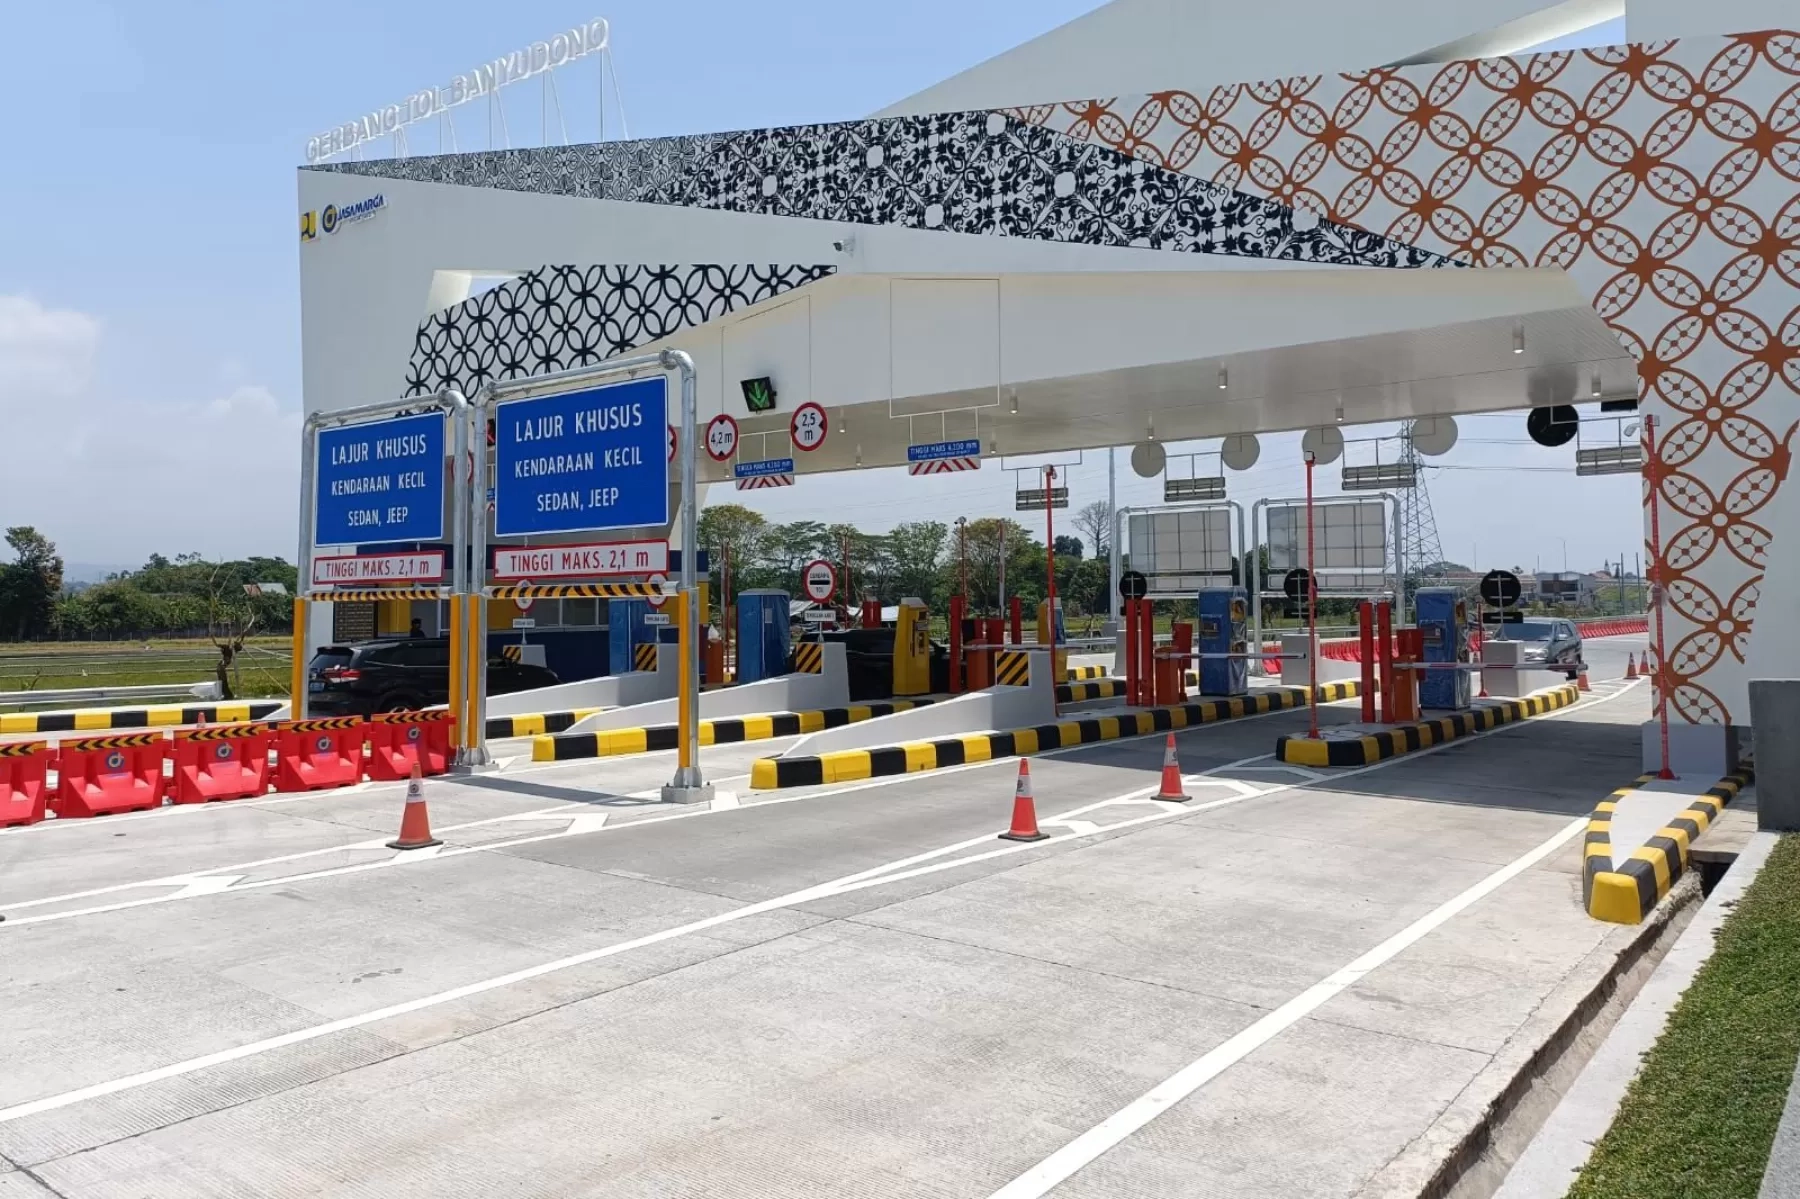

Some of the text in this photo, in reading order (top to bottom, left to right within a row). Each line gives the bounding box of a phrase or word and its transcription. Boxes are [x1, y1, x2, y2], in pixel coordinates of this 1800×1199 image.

[306, 17, 608, 162] GERBANG TOL BANYUDONO
[515, 403, 642, 442] LAJUR KHUSUS
[802, 412, 816, 428] 2,5
[710, 431, 733, 447] 4,2 m
[804, 429, 813, 441] m
[332, 433, 427, 465] LAJUR KHUSUS
[514, 446, 643, 479] KENDARAAN KECIL
[331, 471, 426, 496] KENDARAAN KECIL
[537, 487, 619, 512] SEDAN, JEEP
[348, 506, 408, 527] SEDAN, JEEP
[325, 558, 430, 578] TINGGI MAKS. 2,1 m
[511, 549, 649, 572] TINGGI MAKS. 2,1 m
